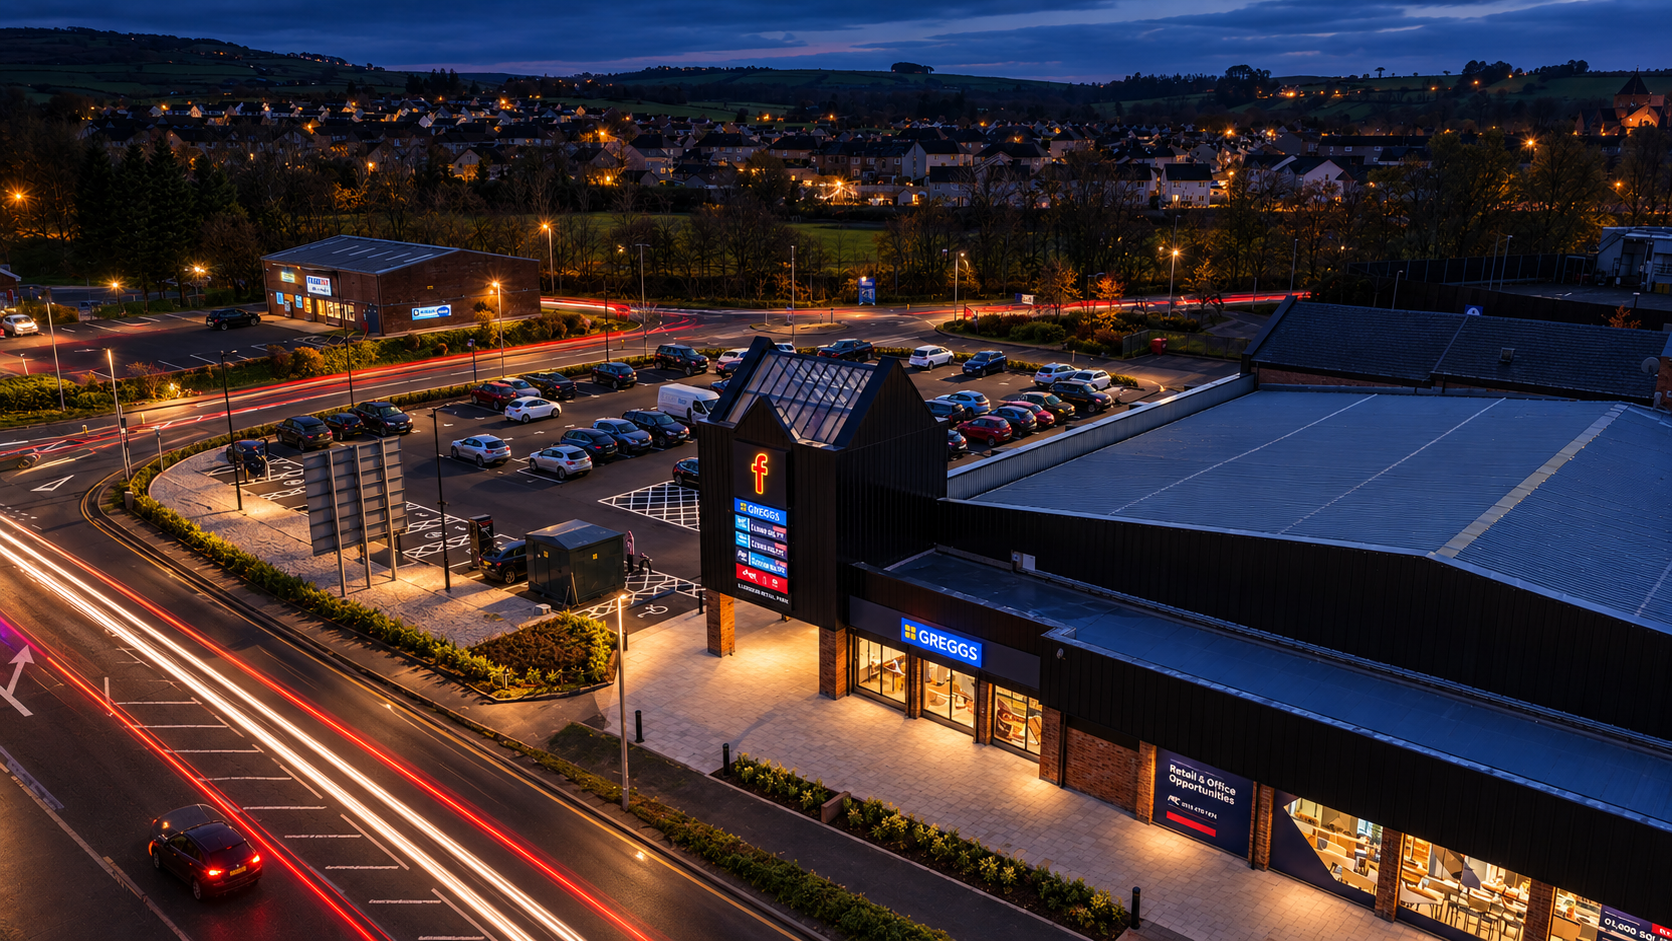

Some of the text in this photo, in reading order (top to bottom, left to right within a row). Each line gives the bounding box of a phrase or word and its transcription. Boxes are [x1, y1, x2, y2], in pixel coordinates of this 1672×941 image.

[747, 504, 780, 522] GREGGS
[919, 630, 977, 660] GREGGS
[1168, 774, 1235, 805] Opportunities
[1169, 764, 1197, 781] Retail
[1206, 778, 1236, 796] Office
